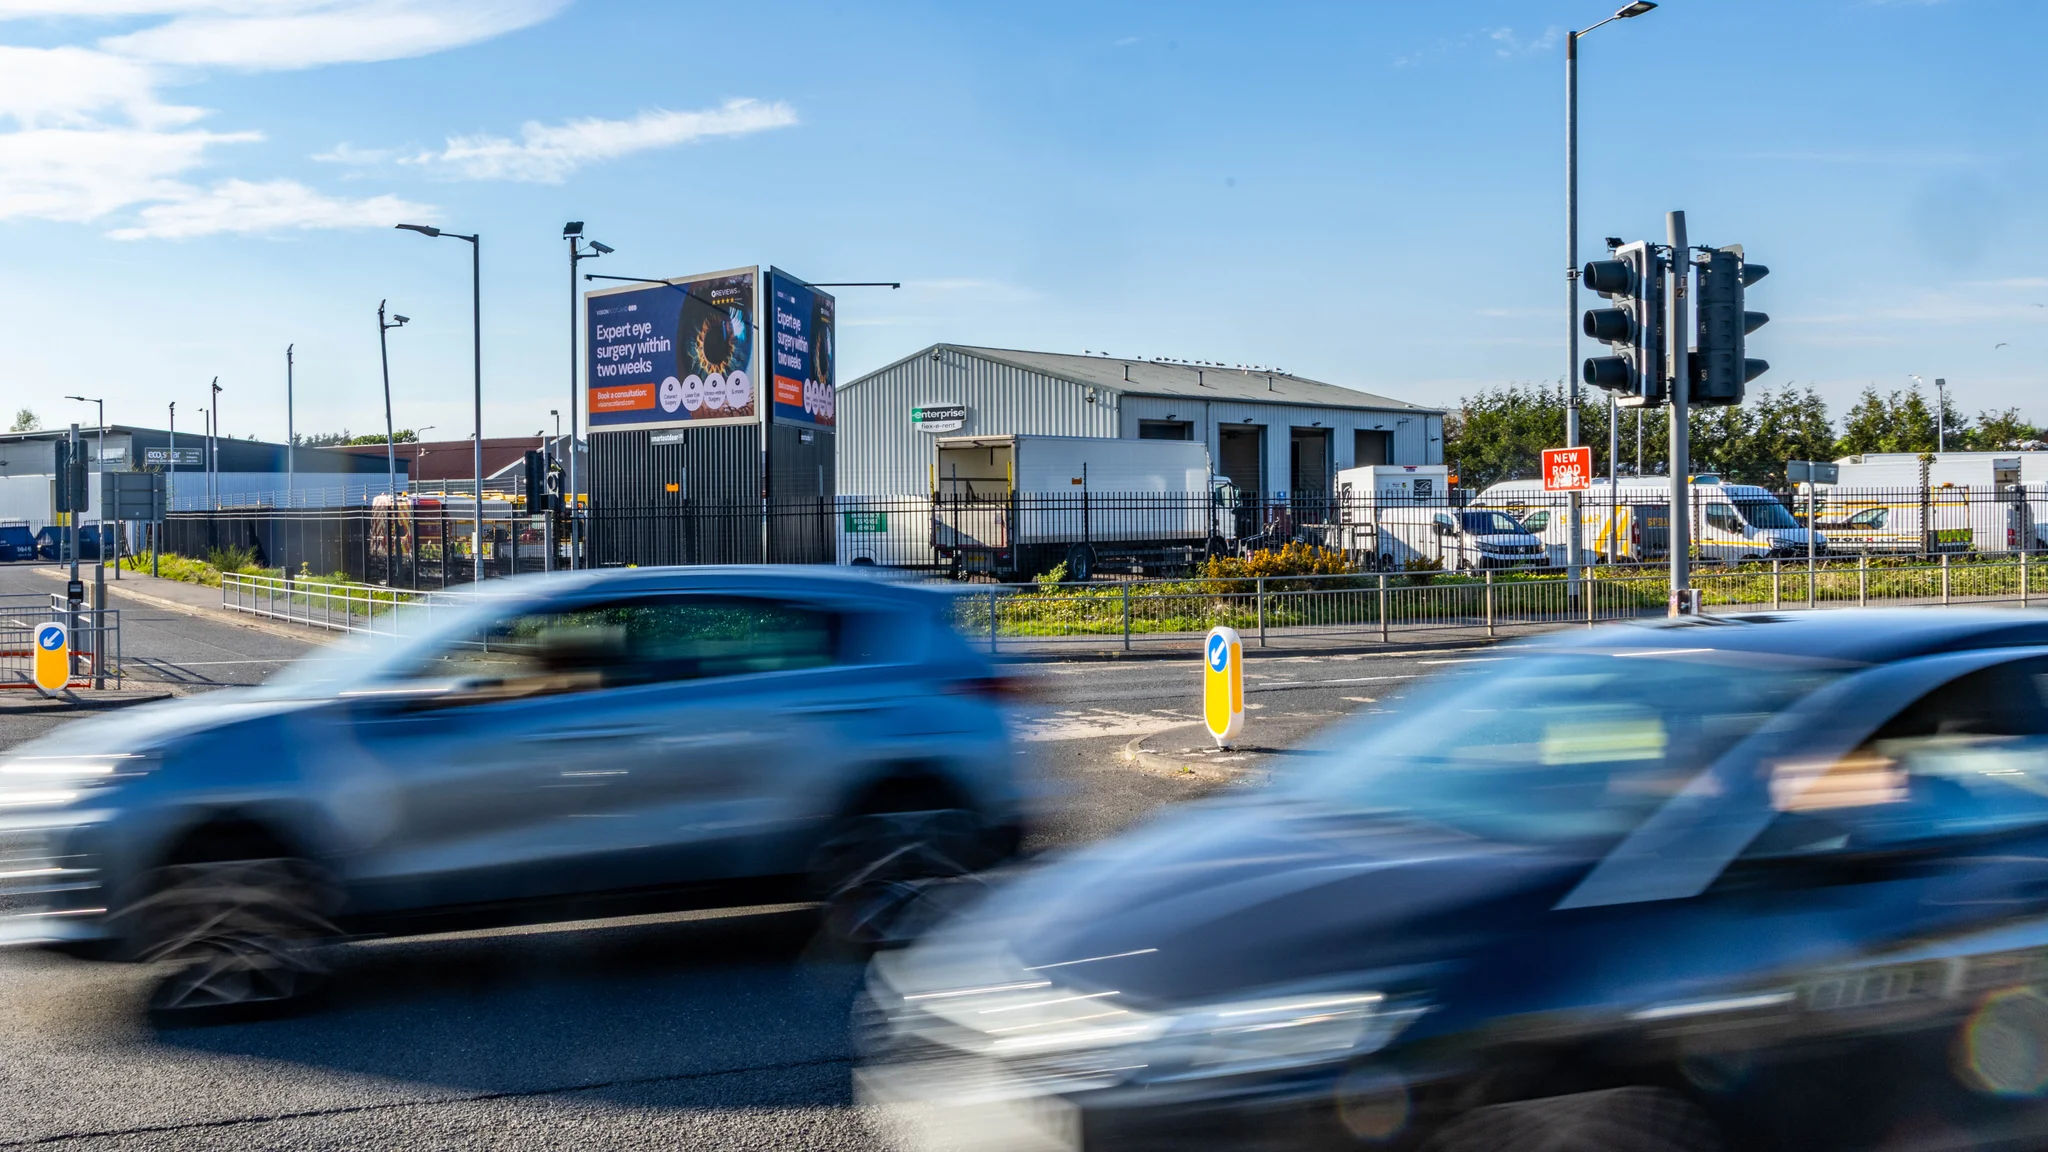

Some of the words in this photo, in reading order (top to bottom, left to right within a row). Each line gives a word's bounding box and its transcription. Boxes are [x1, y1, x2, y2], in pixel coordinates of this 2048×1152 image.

[1676, 287, 1684, 298] 2
[777, 307, 792, 330] Expert
[793, 317, 802, 334] eye
[597, 322, 631, 343] Expert
[632, 322, 652, 340] eye
[596, 343, 636, 361] surgery
[637, 336, 671, 355] within
[597, 363, 617, 377] two
[618, 357, 652, 375] weeks
[597, 391, 611, 400] Book
[615, 389, 648, 398] consultation:
[913, 408, 964, 420] enterprise
[921, 422, 956, 430] flex-e-rent
[1554, 452, 1578, 464] NEW
[1552, 464, 1581, 477] ROAD
[1547, 475, 1587, 488] LAUT
